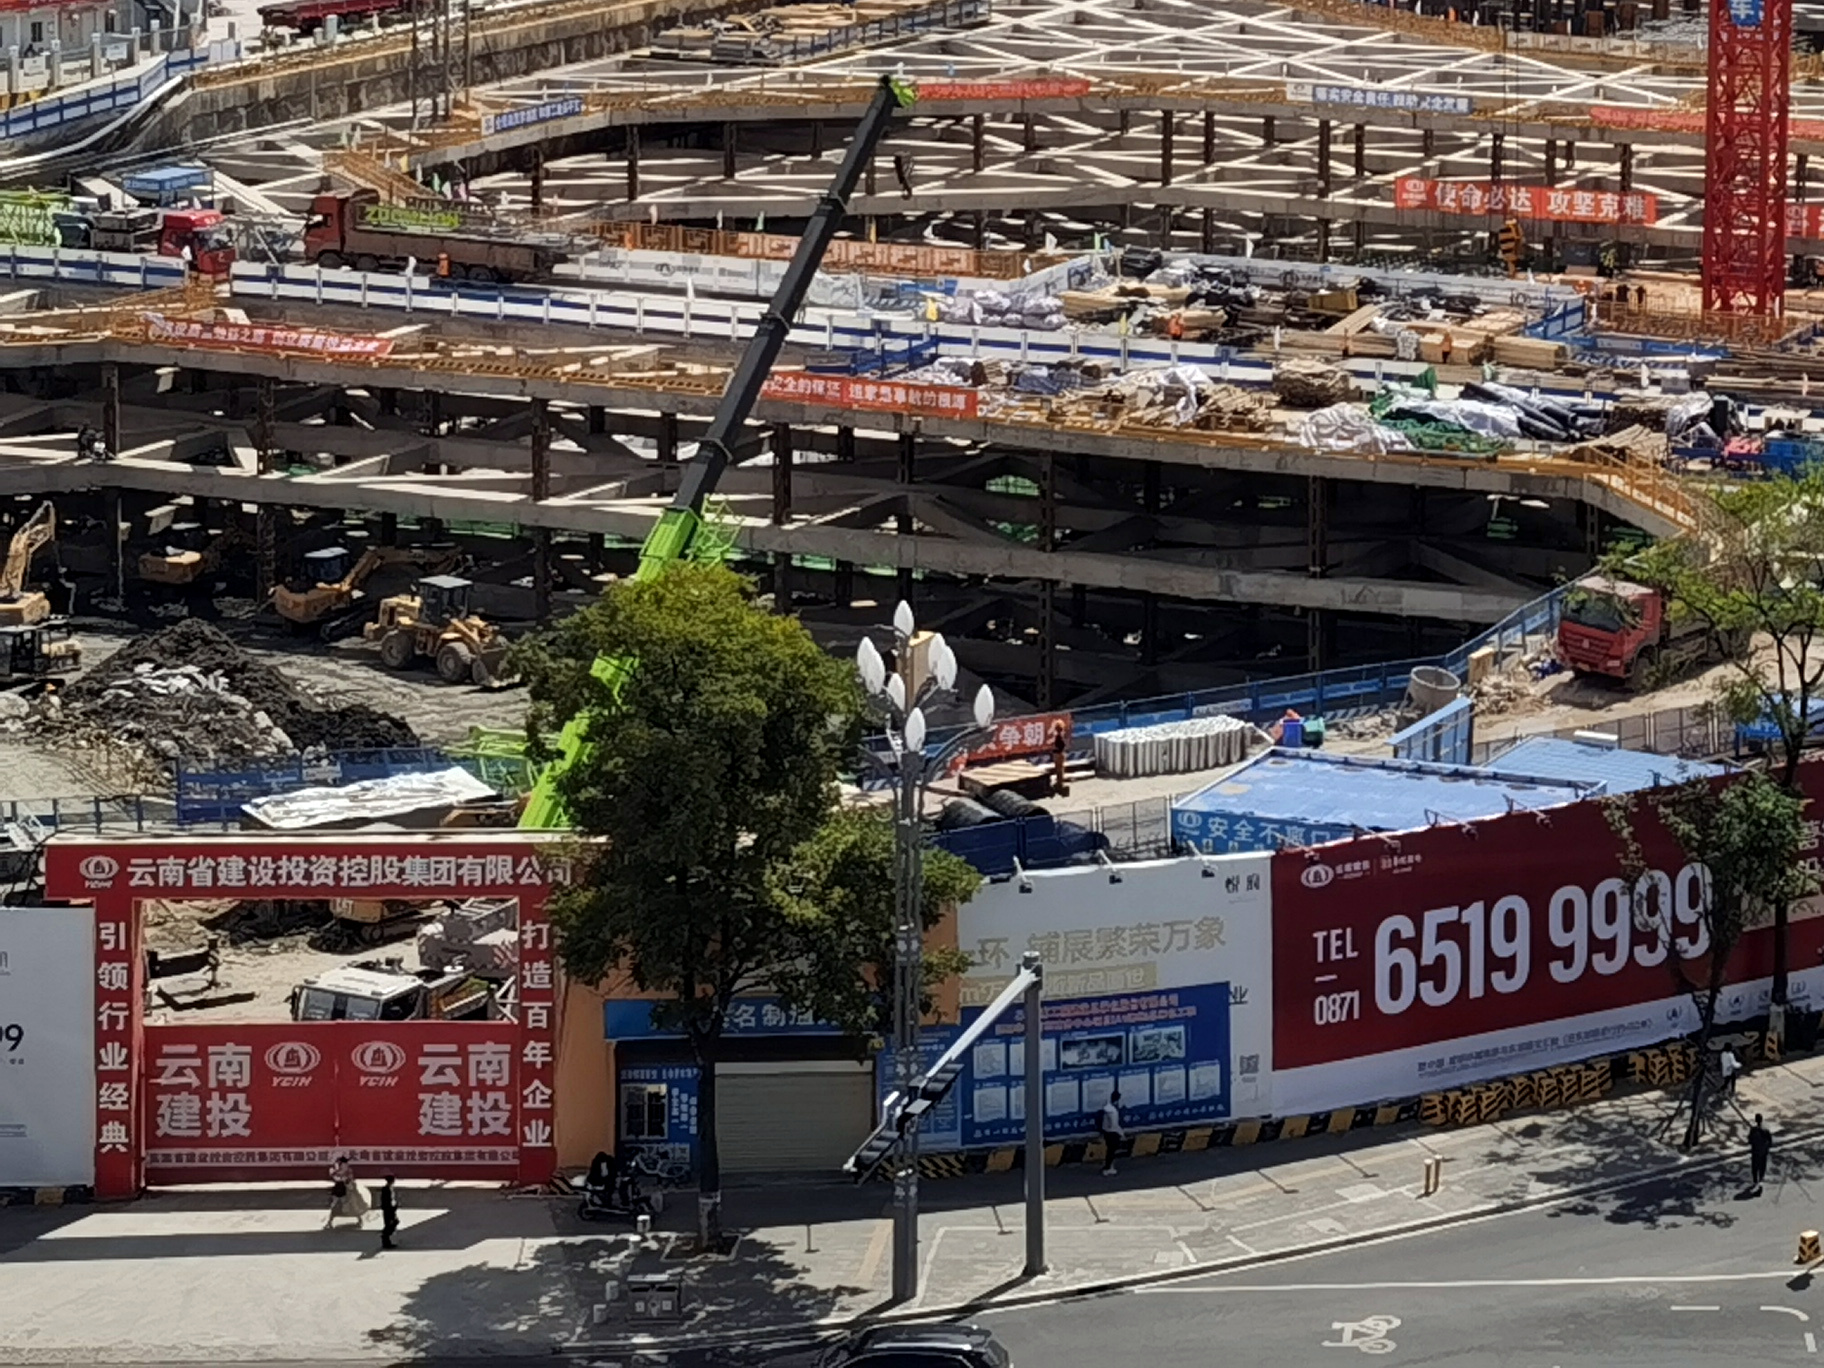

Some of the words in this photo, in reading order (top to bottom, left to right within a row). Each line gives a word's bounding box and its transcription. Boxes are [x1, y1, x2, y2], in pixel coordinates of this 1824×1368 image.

[1434, 181, 1532, 212] 使命必达
[1547, 190, 1646, 220] 攻坚克难
[126, 854, 572, 887] 云南省建设投资控股集团有限公司
[1313, 927, 1359, 963] TEL
[1374, 894, 1531, 1016] 6519
[1548, 860, 1713, 986] 9999
[1314, 990, 1361, 1026] 0871
[97, 921, 130, 1154] 引领行业经典
[521, 918, 553, 1149] 打造百年企业
[155, 1041, 253, 1089] 云南
[416, 1040, 513, 1088] 云南
[155, 1092, 253, 1139] 建投
[416, 1090, 513, 1137] 建投
